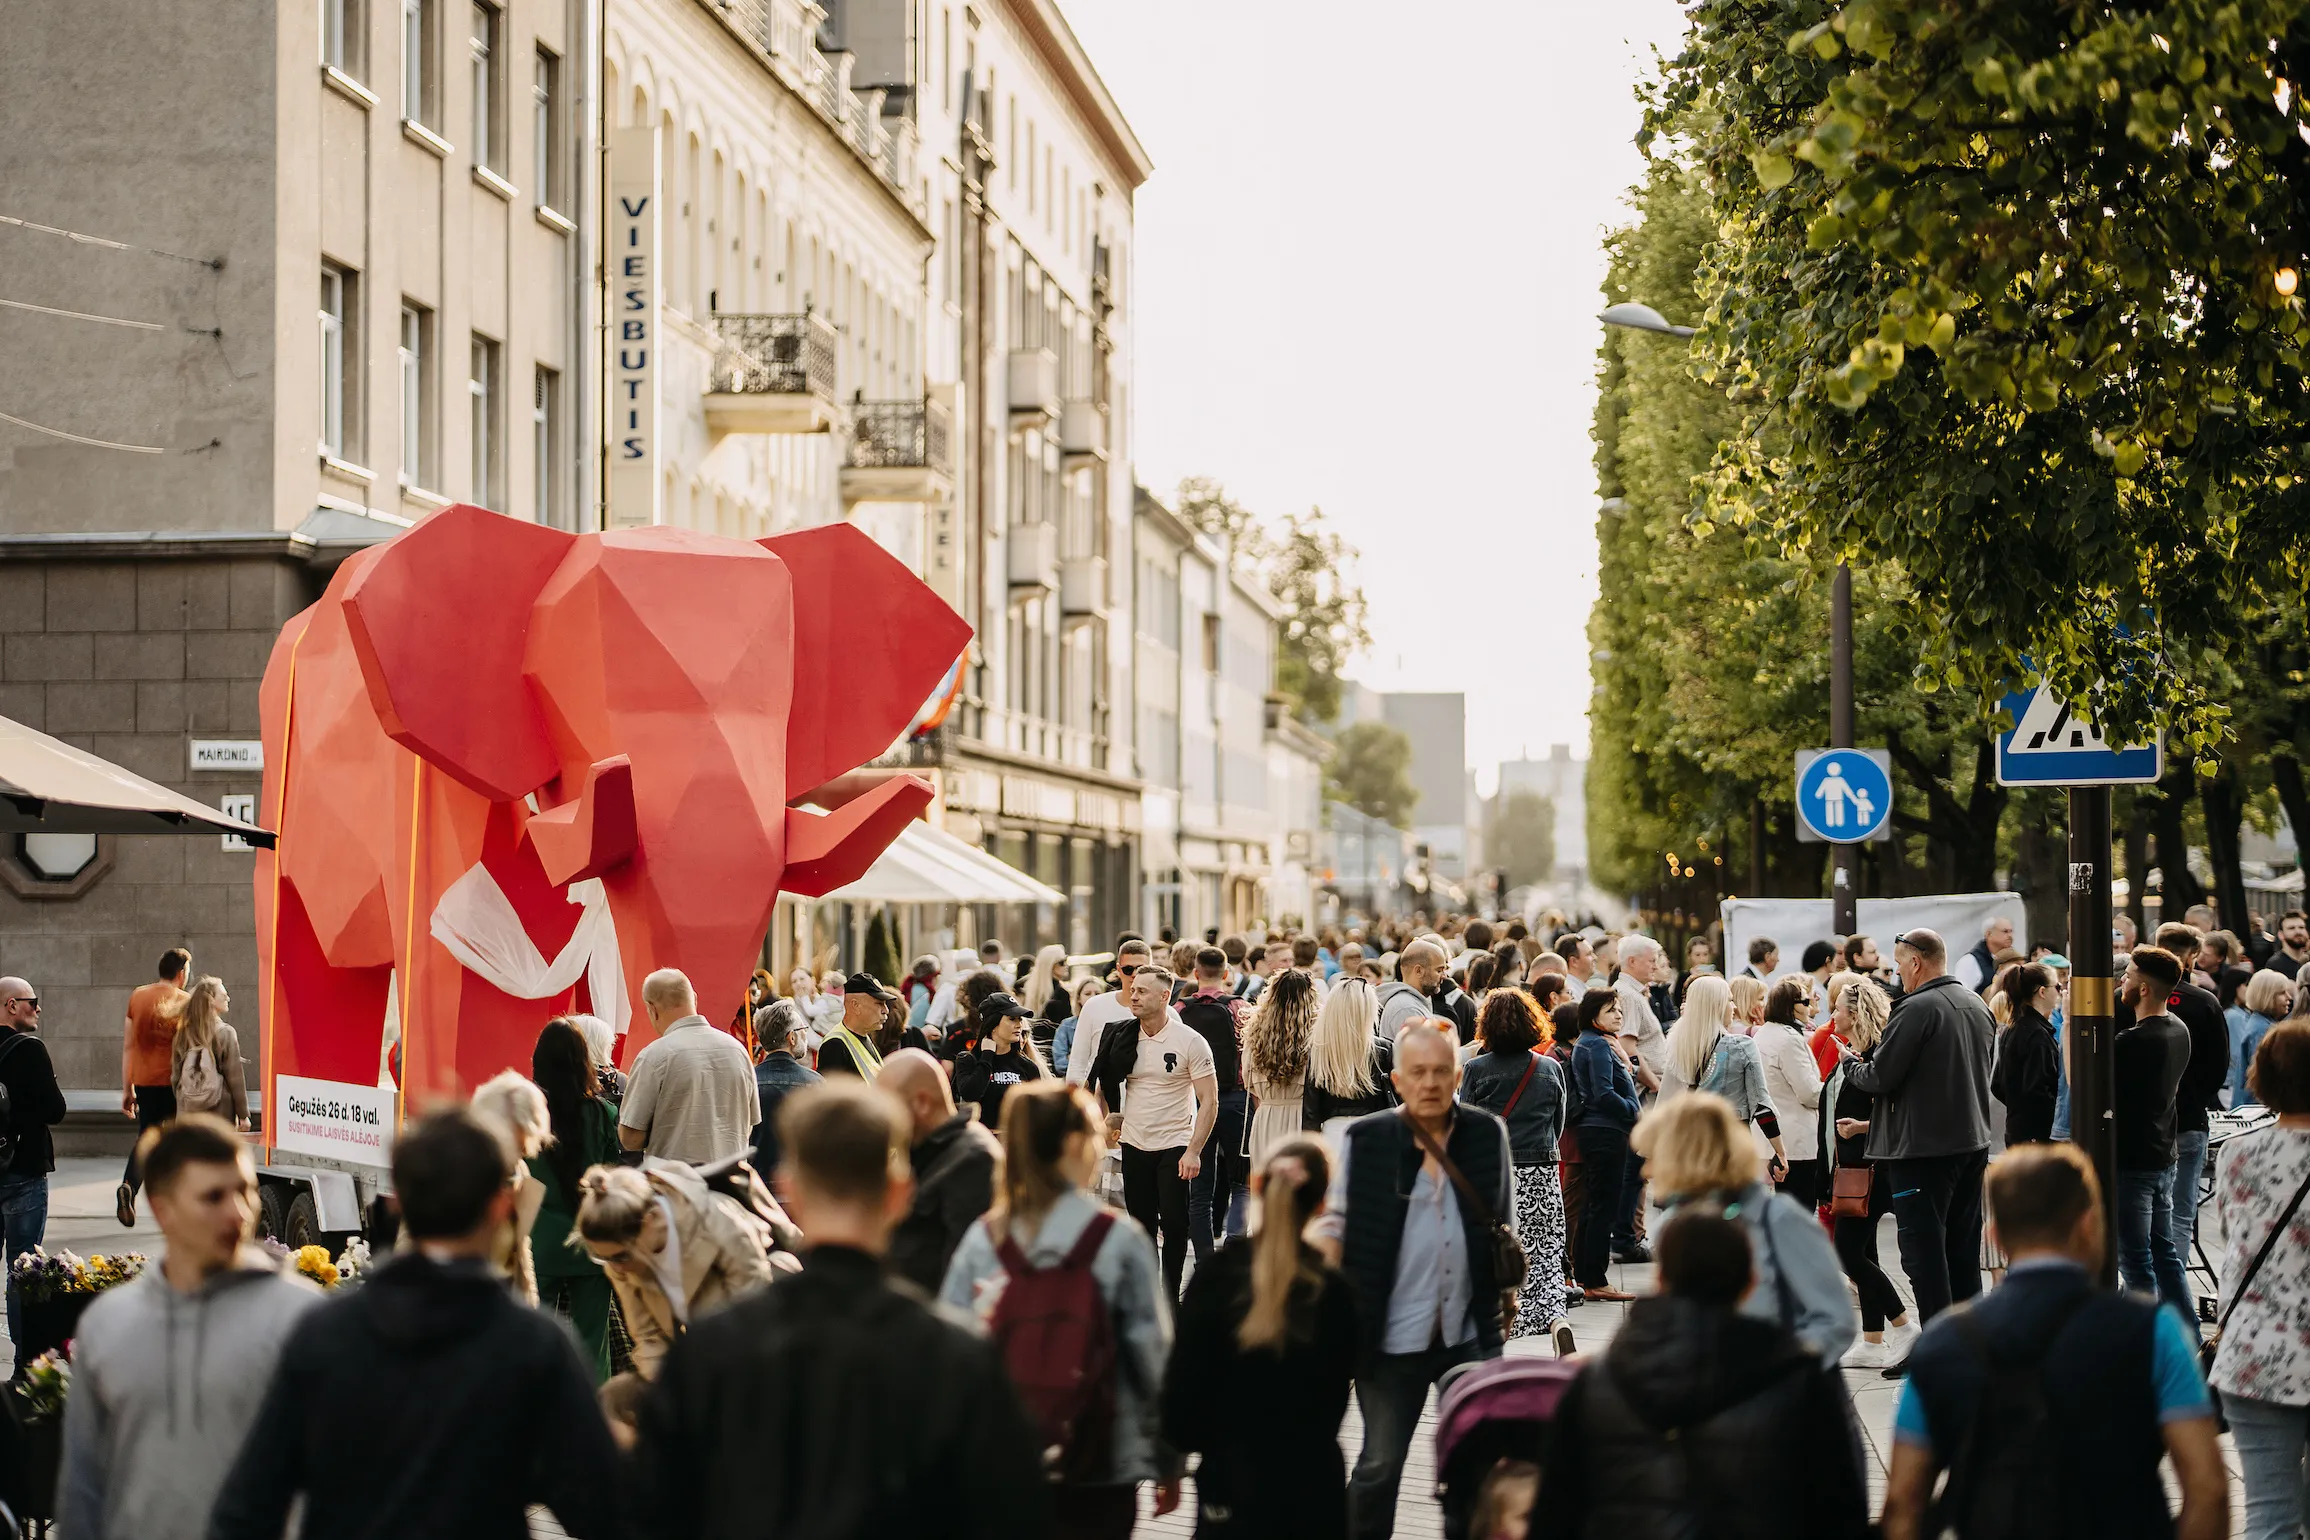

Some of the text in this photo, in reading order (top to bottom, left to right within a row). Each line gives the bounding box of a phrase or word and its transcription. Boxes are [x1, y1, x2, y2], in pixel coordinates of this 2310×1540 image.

[936, 494, 954, 570] TEL
[993, 1072, 1021, 1082] DIESEL
[289, 1095, 380, 1126] Gegužės 26 d. 18 val.
[289, 1121, 380, 1147] SUSITIKIME LAISVĖS ALĖJOJE
